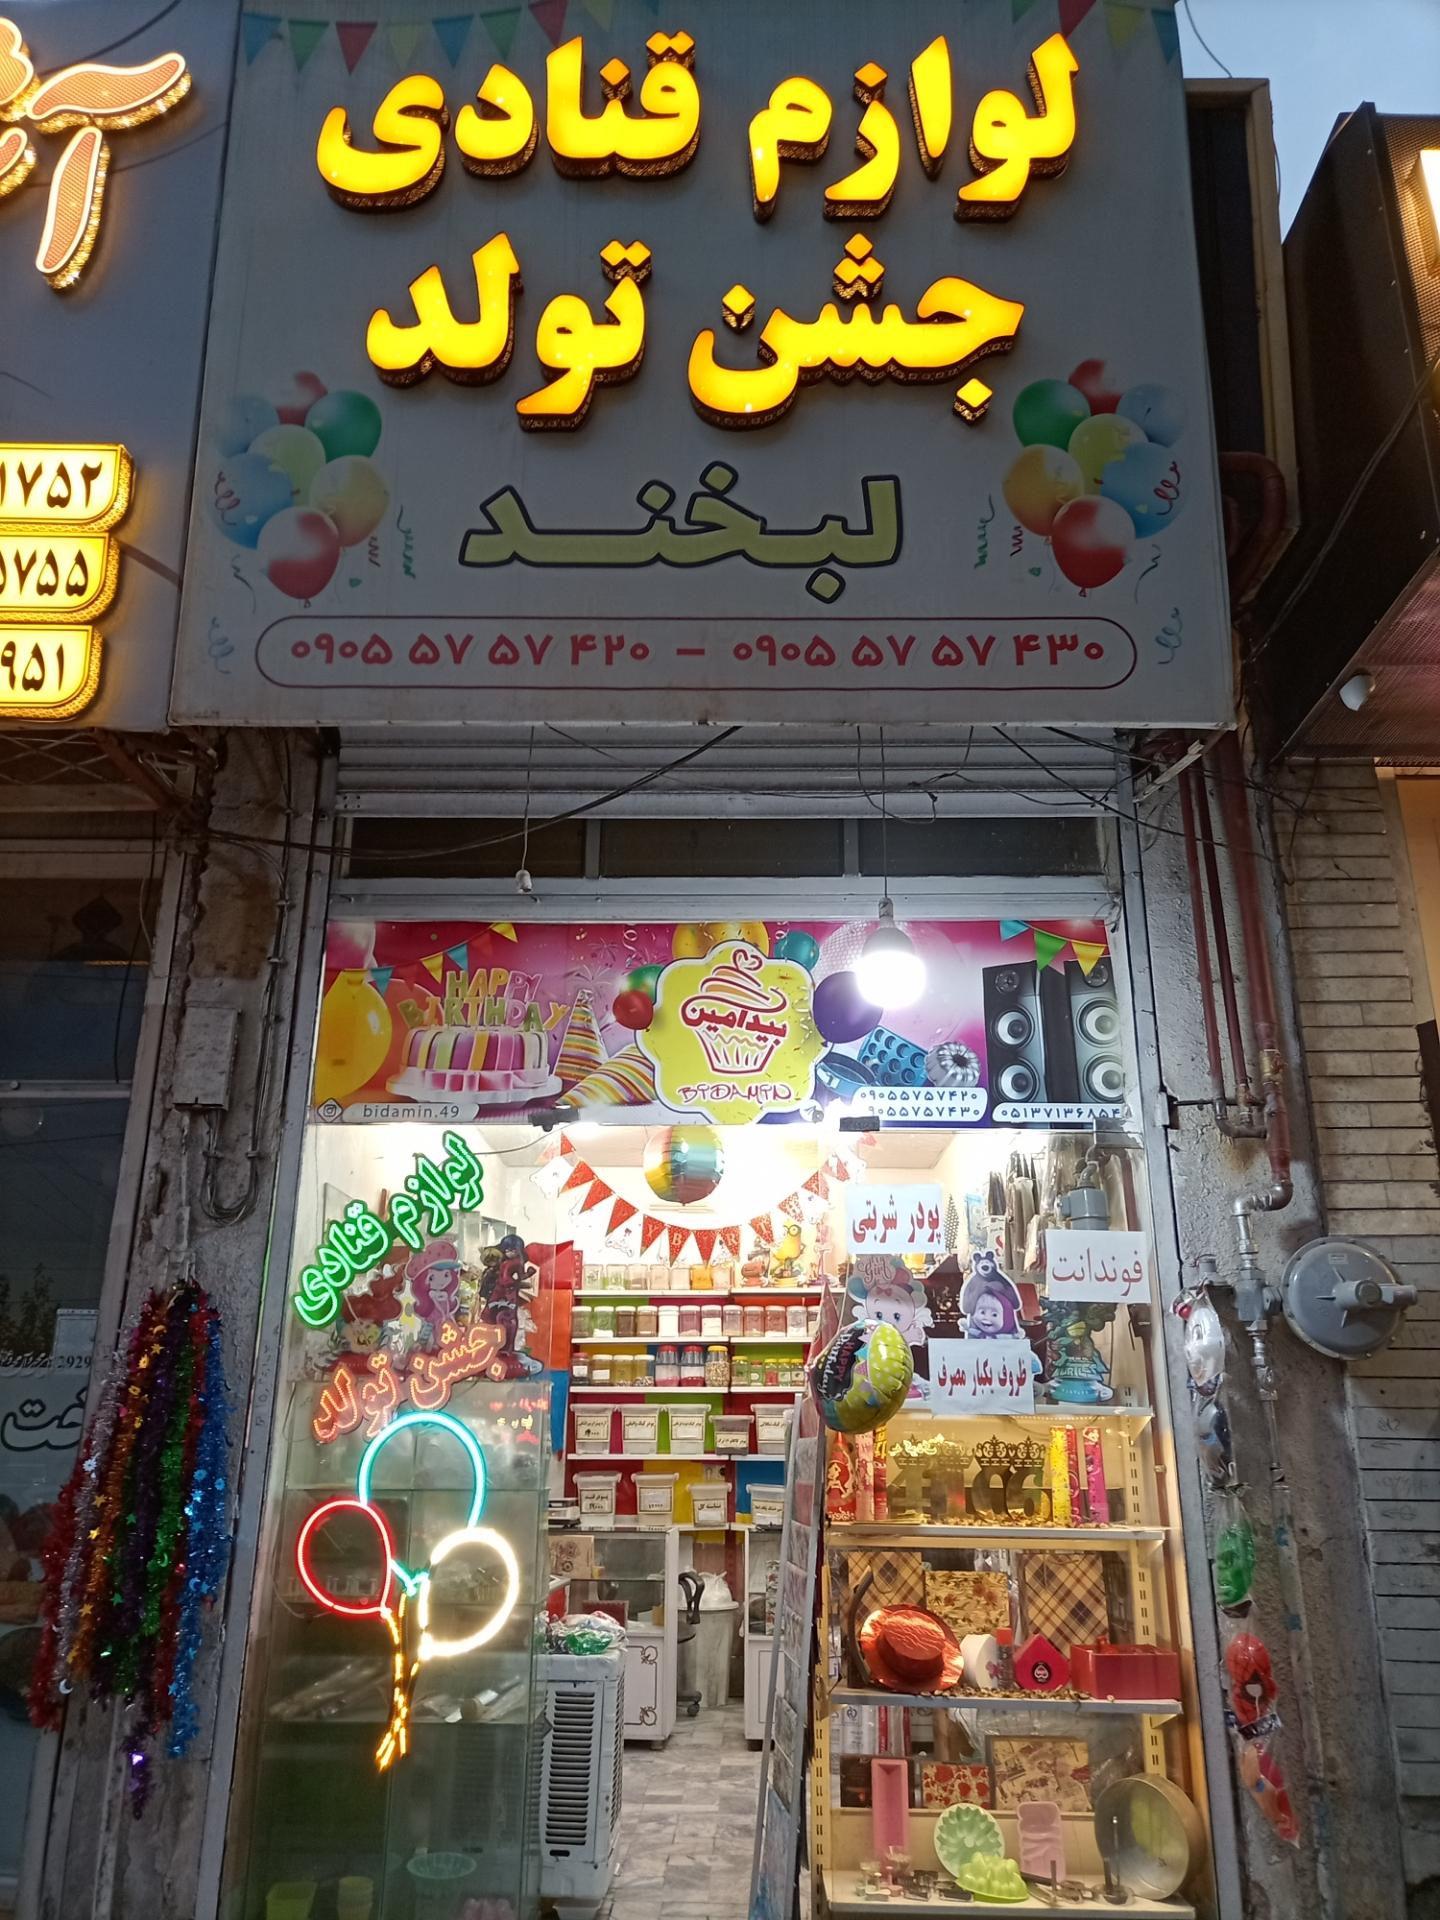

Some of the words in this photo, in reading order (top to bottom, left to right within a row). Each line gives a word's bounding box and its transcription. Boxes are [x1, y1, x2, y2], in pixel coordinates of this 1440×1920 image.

[316, 31, 702, 203] قنادی
[749, 33, 1080, 210] لوازم
[366, 232, 653, 422] تولد
[688, 233, 1025, 422] جشن
[459, 461, 903, 604] لبخند
[0, 548, 89, 597] ۷۵۵
[446, 967, 543, 1002] HAPPY
[397, 997, 571, 1032] BIRTHDAY
[681, 1001, 789, 1047] بیدامین
[363, 1103, 460, 1118] bidamin.49
[678, 1083, 792, 1105] BIDAMIN
[866, 1105, 980, 1118] ۹۰۵۵۷۵۷۴۳۰
[390, 1131, 484, 1249] لوازم
[852, 1193, 898, 1244] شربتی
[907, 1200, 942, 1245] پودر
[294, 1200, 390, 1328] قنادی
[1052, 1247, 1143, 1297] فوندانت
[409, 1321, 507, 1410] جشن
[817, 1332, 853, 1394] Birthday
[834, 1341, 856, 1382] HAPPY
[937, 1355, 967, 1397] مصرف
[997, 1354, 1027, 1397] ظروف
[312, 1353, 399, 1439] تولد
